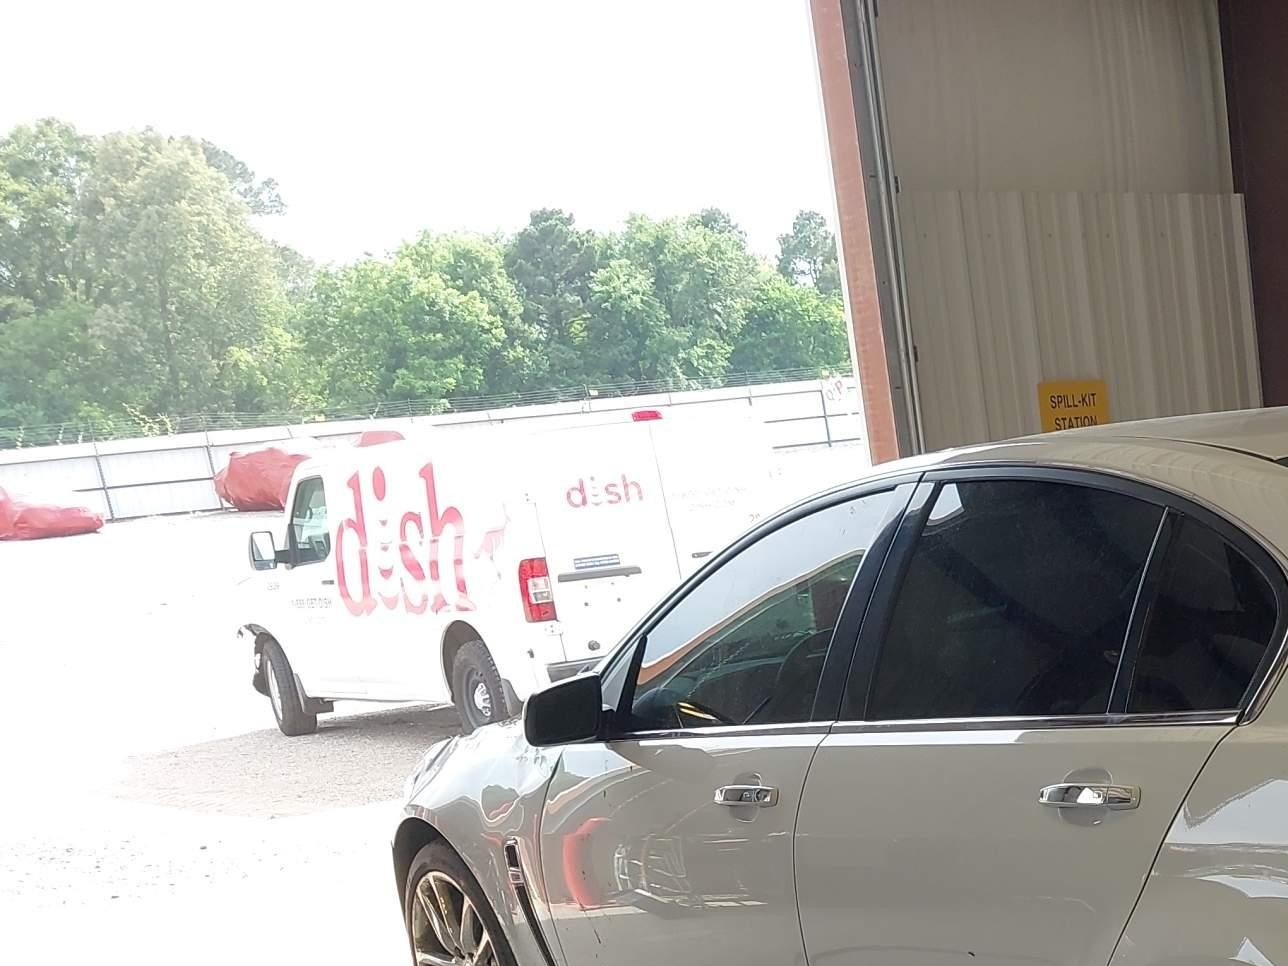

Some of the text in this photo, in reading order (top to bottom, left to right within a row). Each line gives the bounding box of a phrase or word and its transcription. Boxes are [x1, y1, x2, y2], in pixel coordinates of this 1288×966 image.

[1050, 393, 1097, 409] SPILL-KIT
[1055, 416, 1098, 430] STATION
[566, 474, 643, 508] dish
[335, 462, 477, 616] dish
